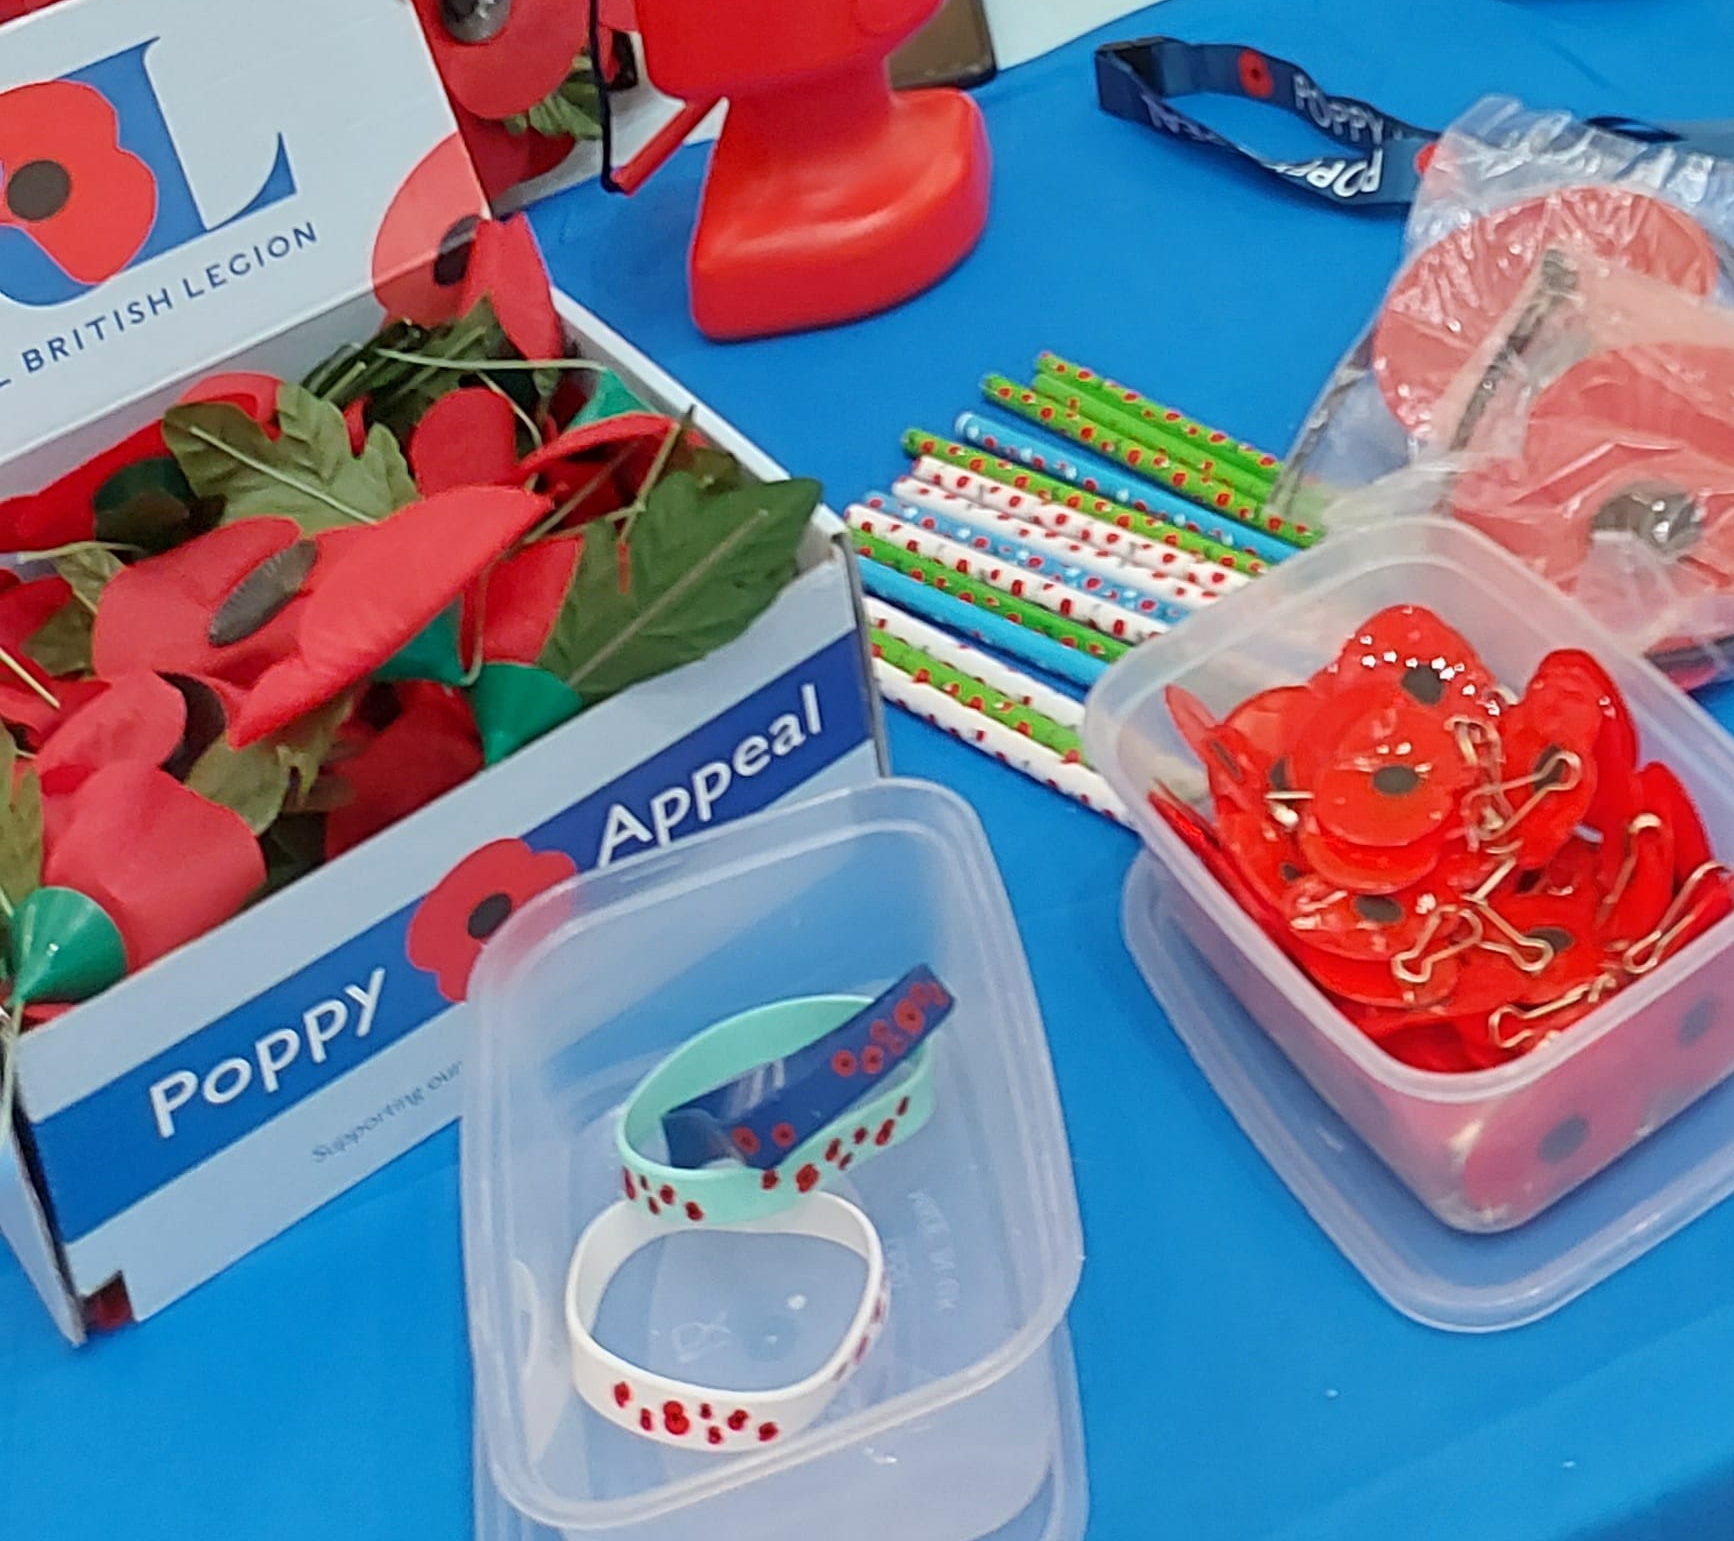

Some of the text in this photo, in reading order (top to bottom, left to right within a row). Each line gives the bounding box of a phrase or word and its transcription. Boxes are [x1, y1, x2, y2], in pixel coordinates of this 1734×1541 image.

[1292, 71, 1385, 147] POPPY
[21, 220, 319, 374] BRITISH LEGION
[148, 683, 824, 1139] Poppy Appeal
